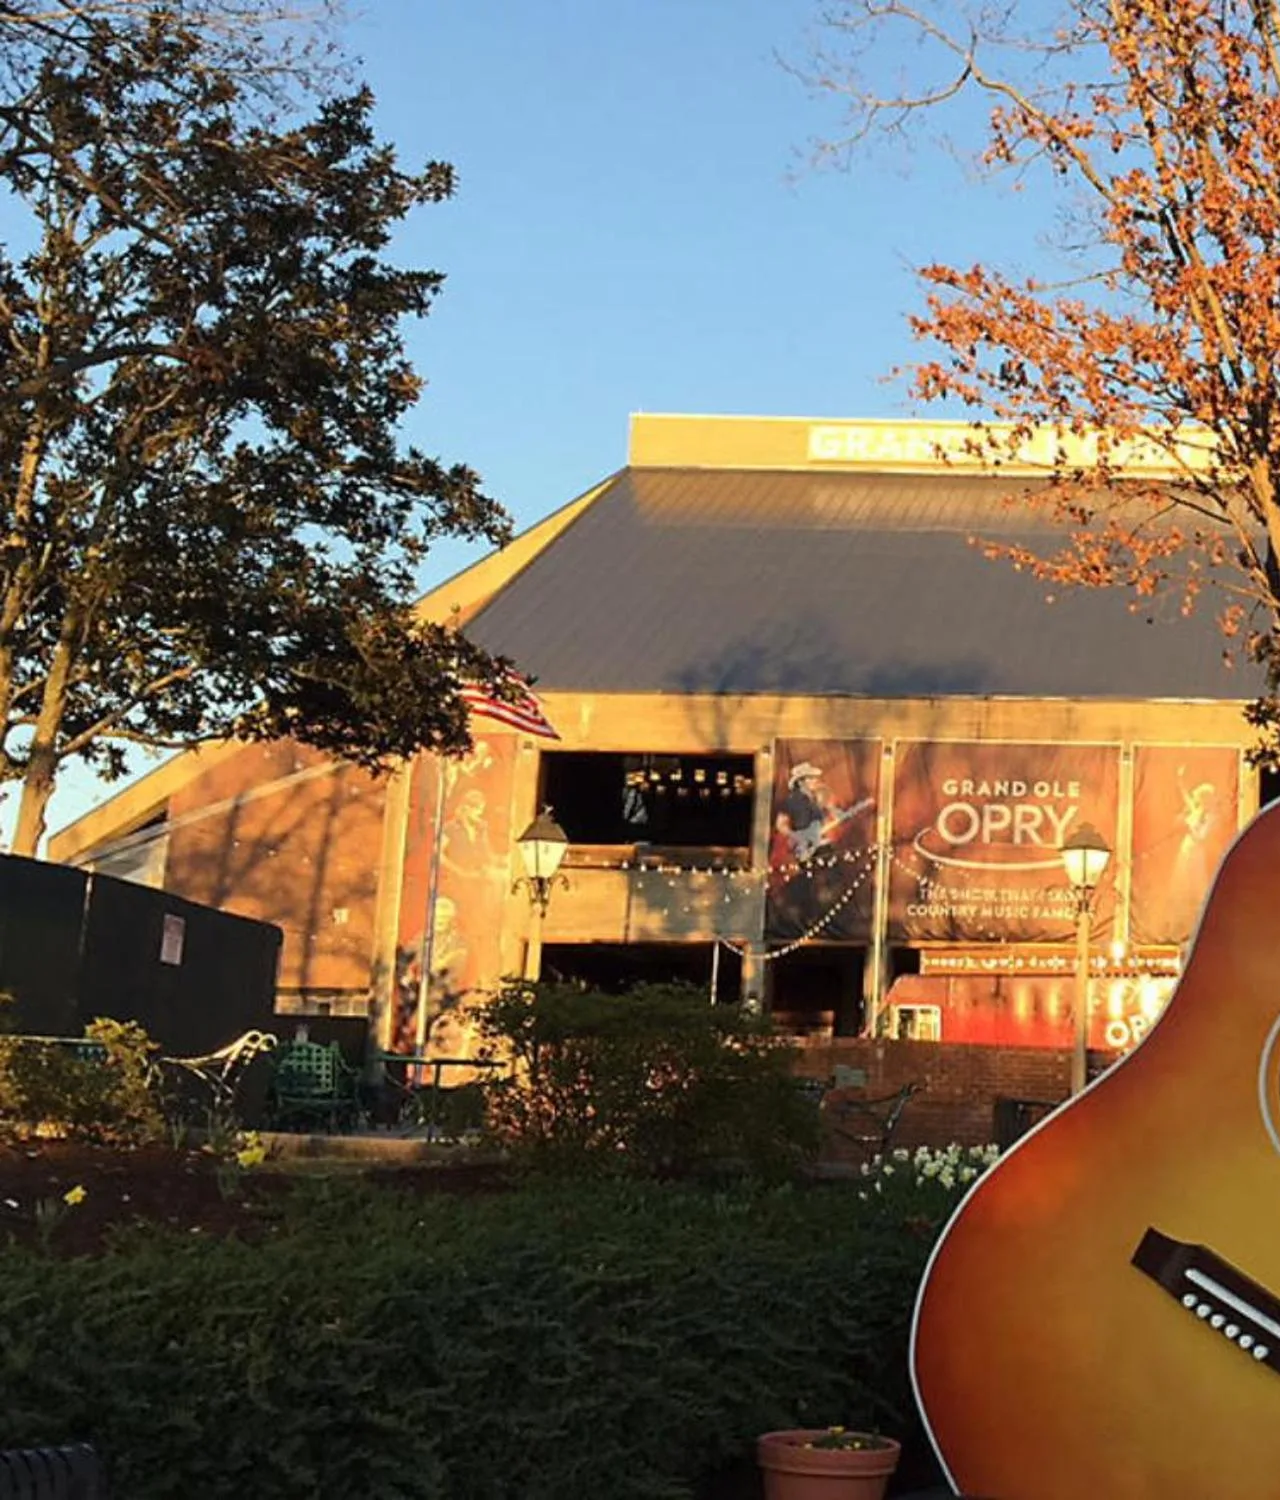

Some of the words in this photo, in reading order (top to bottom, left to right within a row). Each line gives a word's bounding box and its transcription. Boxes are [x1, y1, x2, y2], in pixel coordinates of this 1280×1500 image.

[942, 779, 1027, 798] GRAND
[1033, 780, 1081, 799] OLE
[936, 801, 1079, 848] OPRY
[906, 903, 979, 918] COUNTRY
[981, 904, 1030, 920] MUSIC
